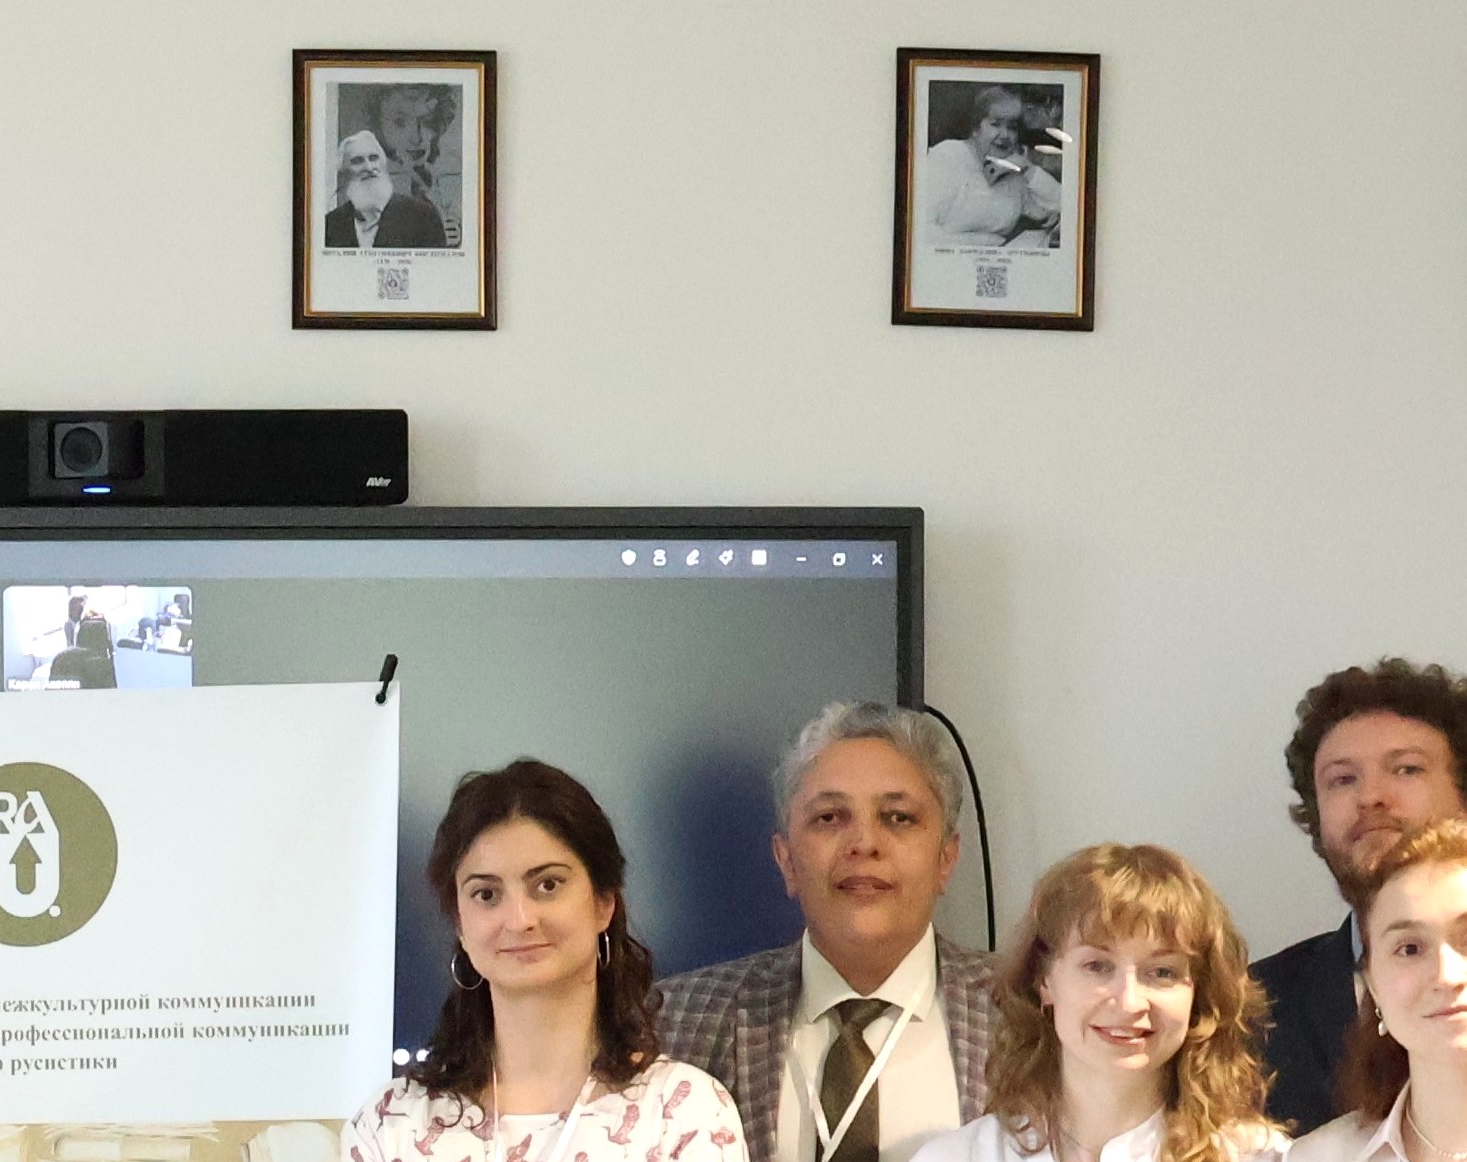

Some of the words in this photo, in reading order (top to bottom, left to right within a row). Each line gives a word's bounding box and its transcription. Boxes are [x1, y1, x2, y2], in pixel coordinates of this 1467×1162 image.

[157, 994, 316, 1013] коммуникации
[192, 1022, 350, 1043] коммуникации
[10, 1056, 118, 1076] русистики
